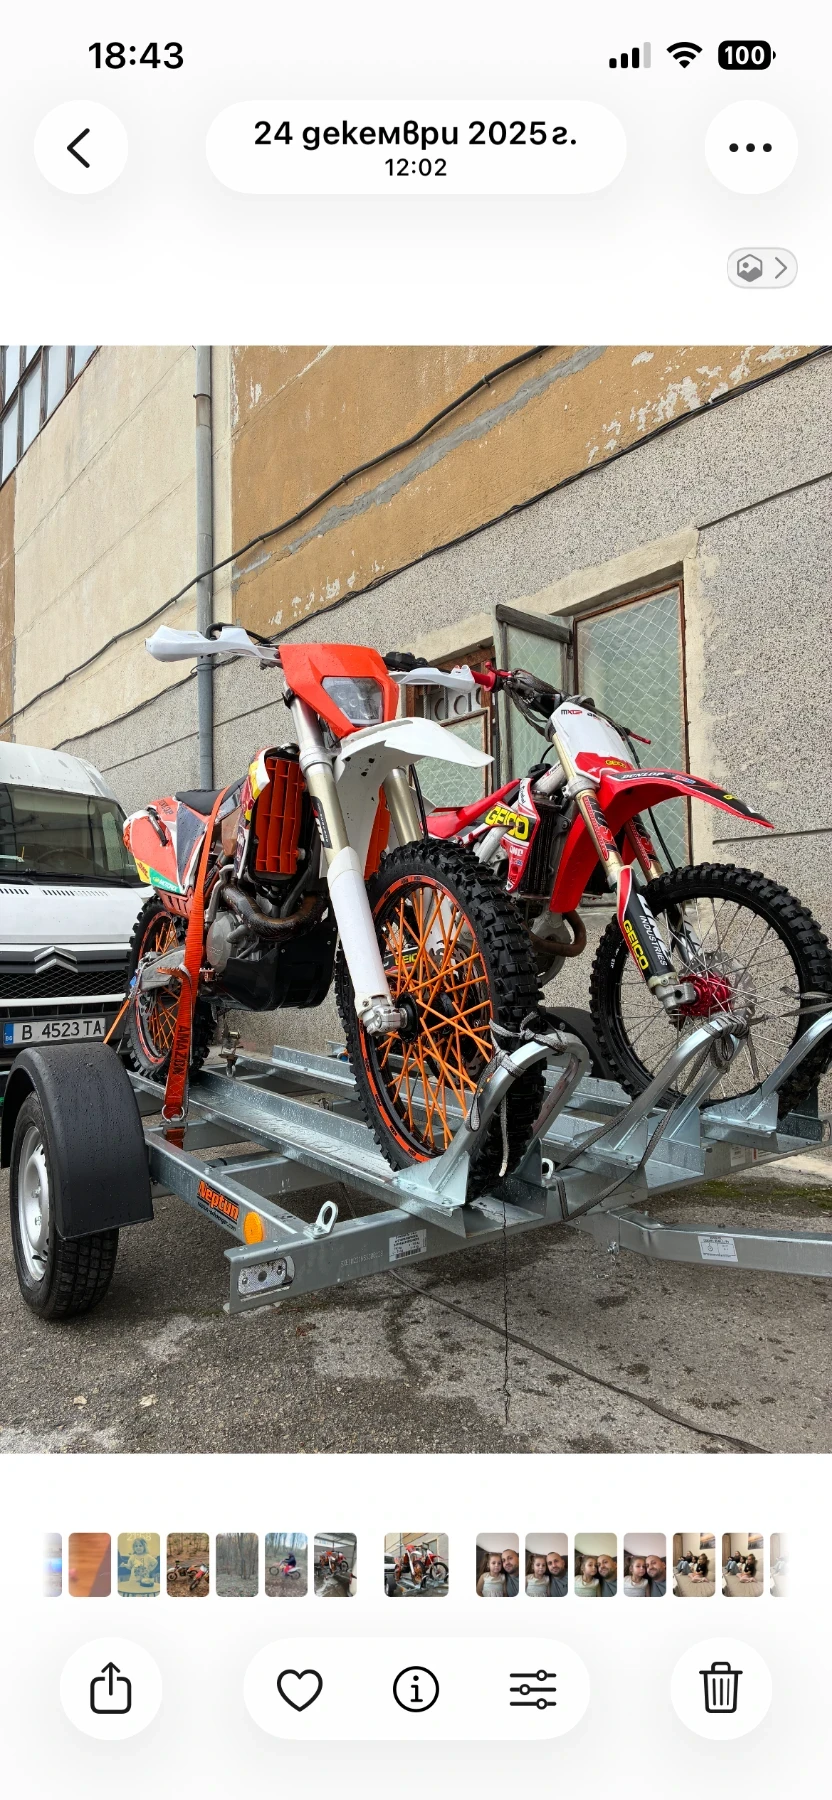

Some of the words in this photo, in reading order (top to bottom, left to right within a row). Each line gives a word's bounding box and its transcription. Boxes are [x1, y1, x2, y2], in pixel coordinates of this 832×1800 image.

[621, 772, 665, 780] DUNLOP
[485, 805, 530, 840] GEICO
[623, 919, 649, 970] GEICO
[639, 915, 668, 966] INDUSTRIES
[21, 1024, 33, 1041] B
[41, 1021, 80, 1039] 4523
[83, 1019, 102, 1036] TA
[197, 1179, 240, 1222] Neptun
